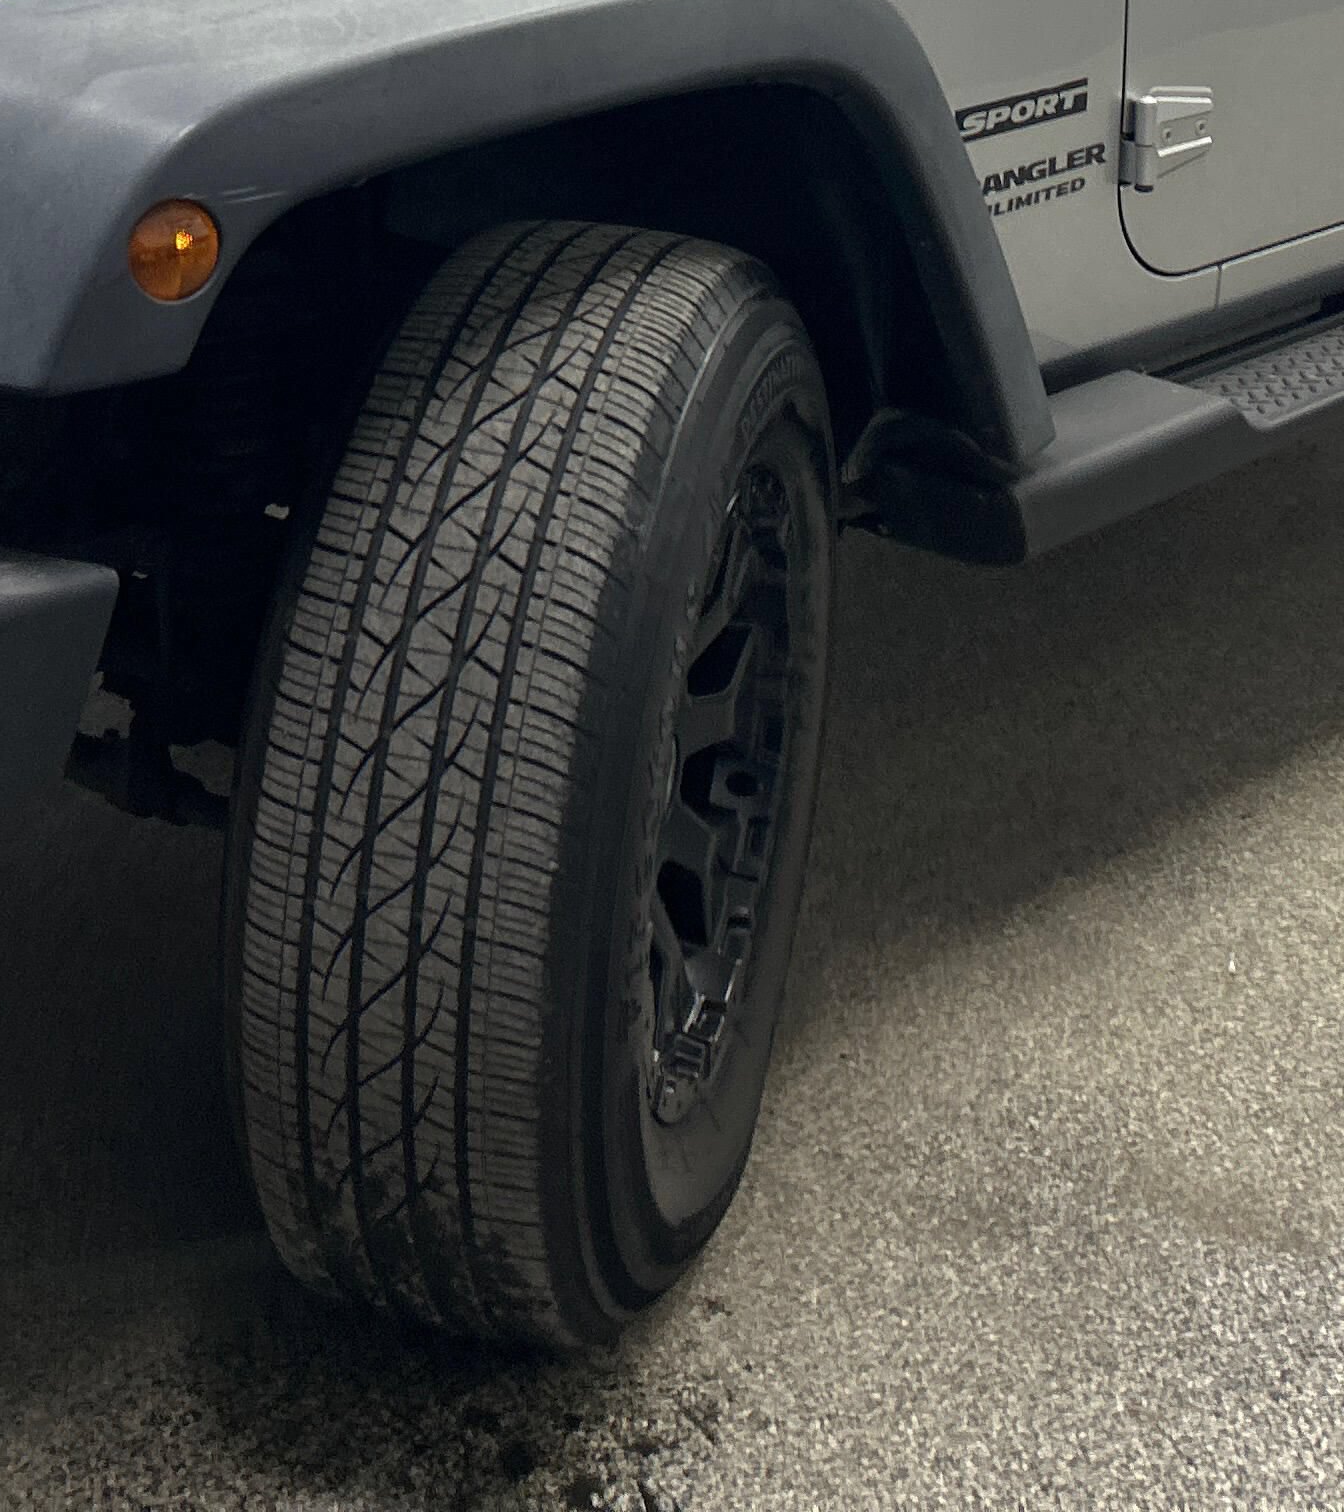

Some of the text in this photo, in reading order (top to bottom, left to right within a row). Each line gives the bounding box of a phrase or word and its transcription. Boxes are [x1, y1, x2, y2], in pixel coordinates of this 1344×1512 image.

[960, 85, 1088, 137] SPORT
[982, 142, 1106, 197] ANGLER
[987, 177, 1086, 216] LIMITED
